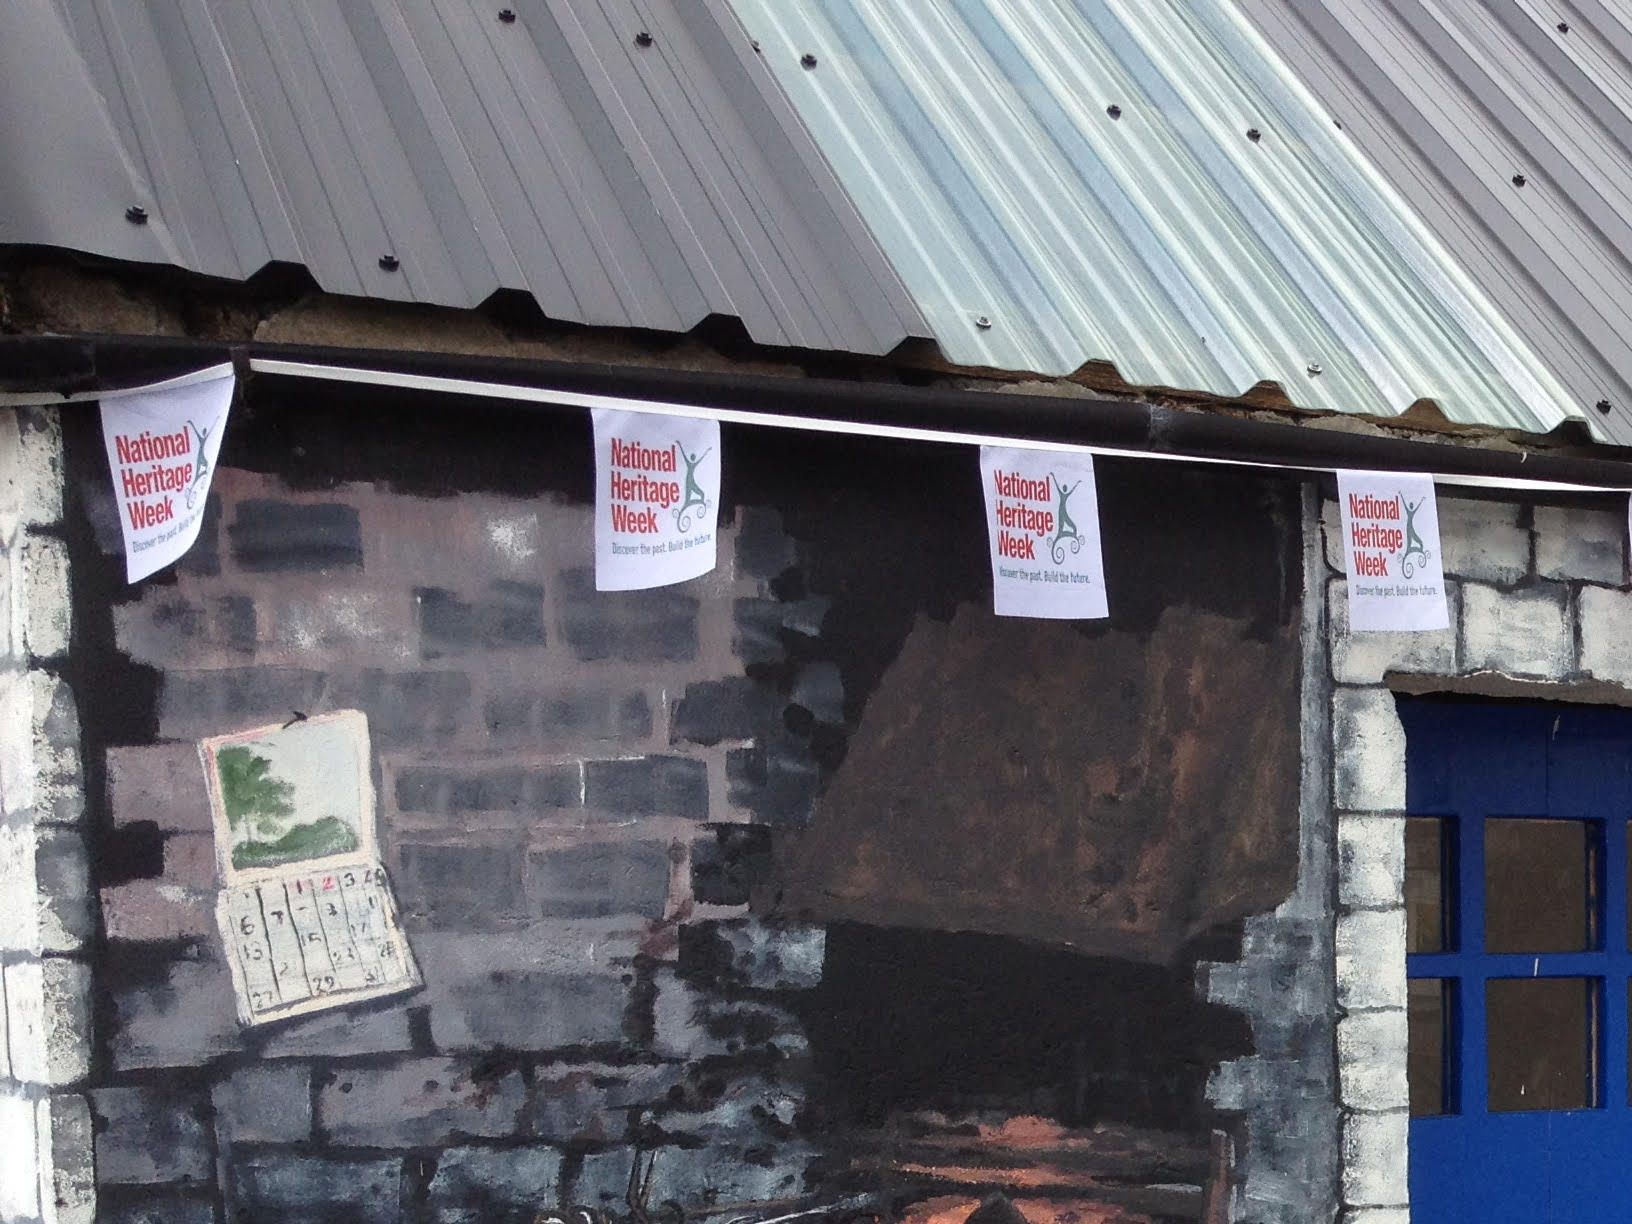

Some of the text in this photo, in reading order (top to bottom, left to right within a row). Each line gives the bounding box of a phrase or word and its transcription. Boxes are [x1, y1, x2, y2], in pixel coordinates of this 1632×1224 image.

[115, 425, 191, 465] National
[611, 437, 677, 472] National
[121, 462, 192, 498] Heritage
[611, 470, 680, 509] Heritage
[994, 469, 1051, 502] National
[127, 495, 174, 530] Week
[611, 503, 659, 534] Week
[996, 499, 1053, 537] Heritage
[1349, 493, 1400, 520] National
[640, 544, 651, 554] the
[685, 539, 693, 549] the
[998, 529, 1035, 560] Week
[1351, 522, 1403, 554] Heritage
[1060, 571, 1069, 583] the
[1353, 550, 1389, 577] Week
